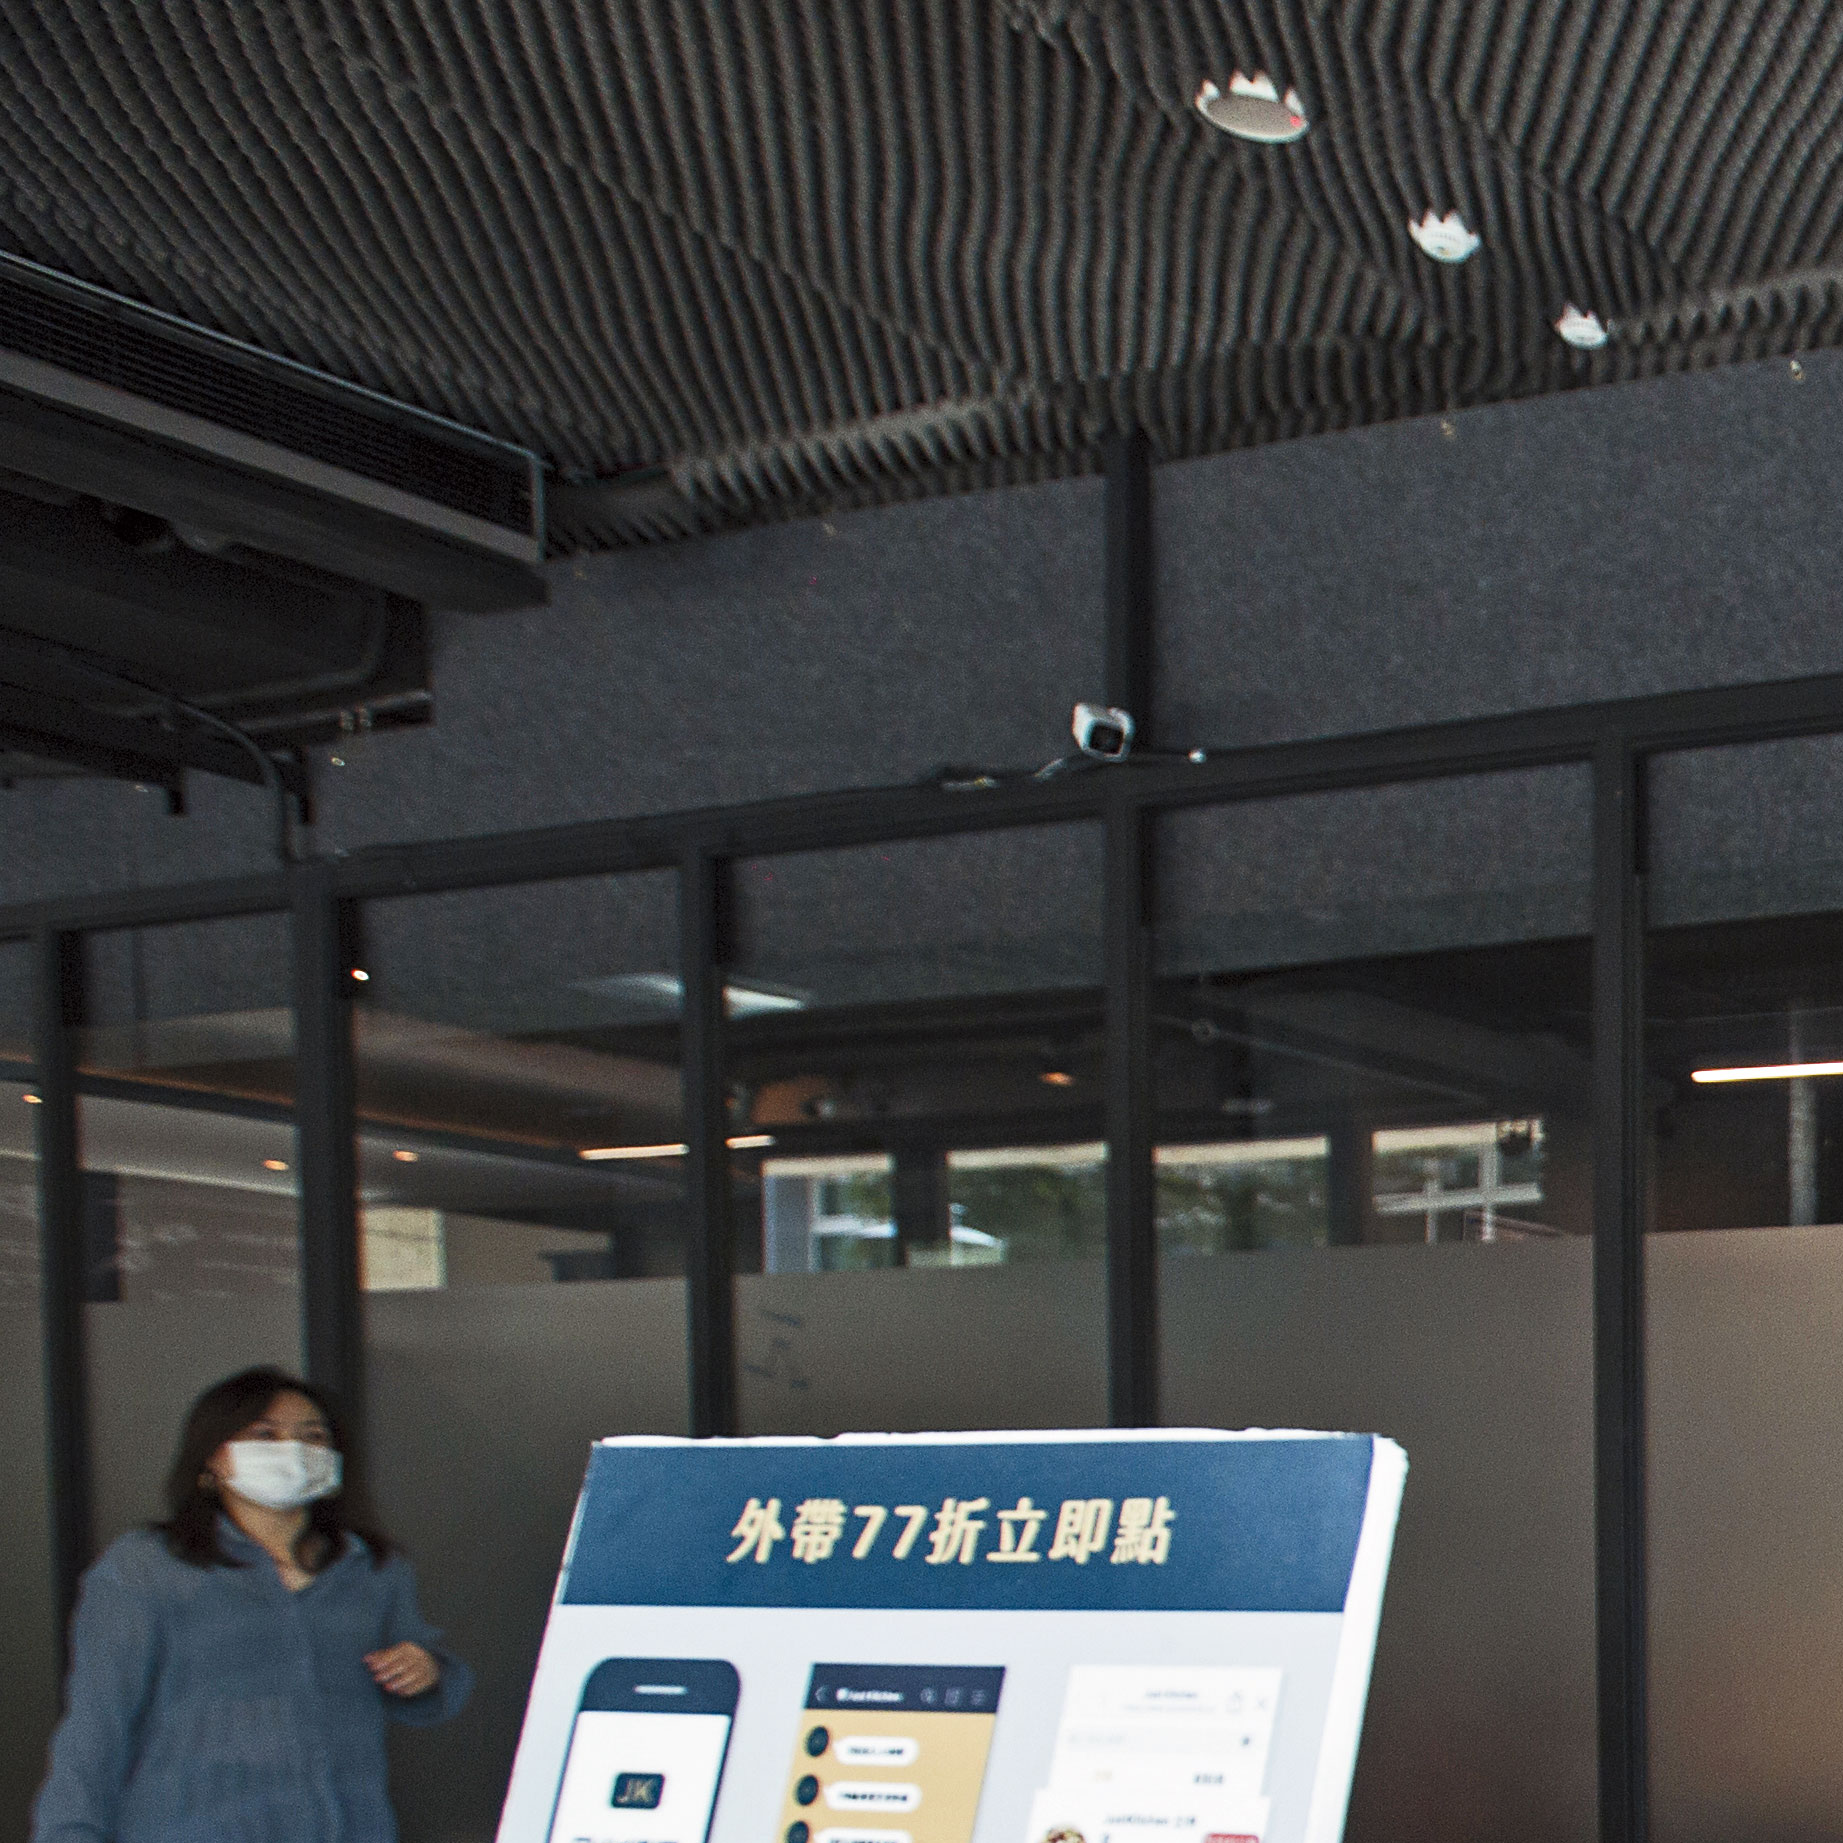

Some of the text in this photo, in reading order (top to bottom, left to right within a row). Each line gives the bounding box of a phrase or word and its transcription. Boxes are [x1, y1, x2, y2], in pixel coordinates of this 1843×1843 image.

[726, 1497, 1177, 1565] 外帶77折立即點
